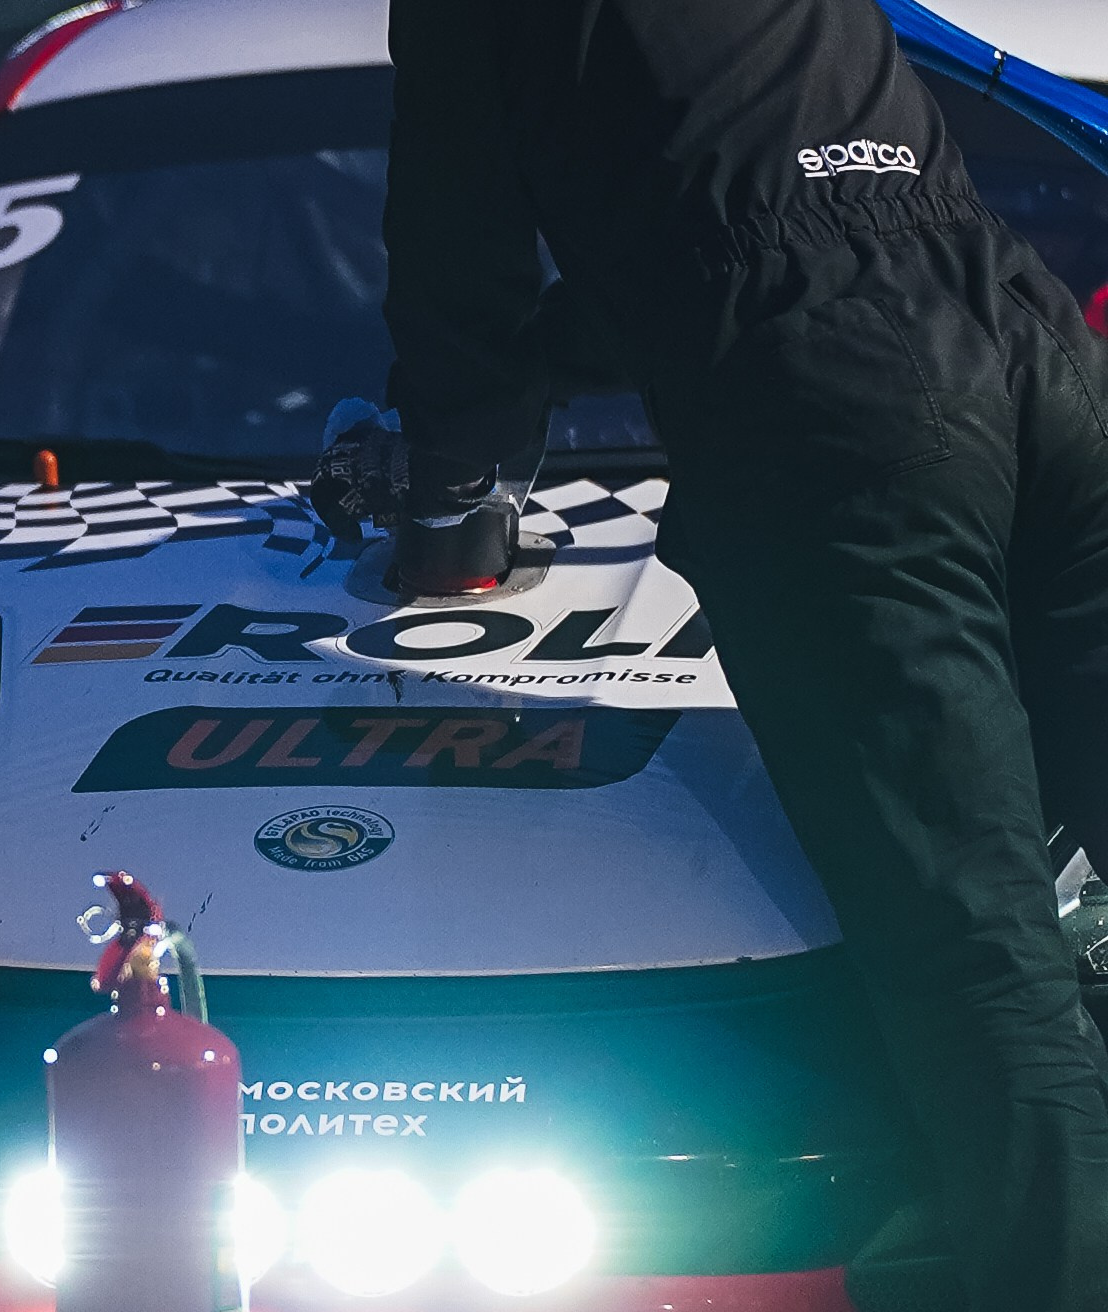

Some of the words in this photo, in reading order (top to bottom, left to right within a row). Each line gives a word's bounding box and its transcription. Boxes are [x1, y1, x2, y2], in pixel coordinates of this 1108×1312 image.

[797, 139, 917, 177] sparco
[143, 668, 303, 685] Qualität
[421, 668, 698, 686] Kompromisse
[164, 717, 587, 771] ULTRA
[325, 809, 385, 837] technology
[267, 845, 298, 866] Made
[303, 858, 343, 868] from
[347, 846, 375, 863] GAS
